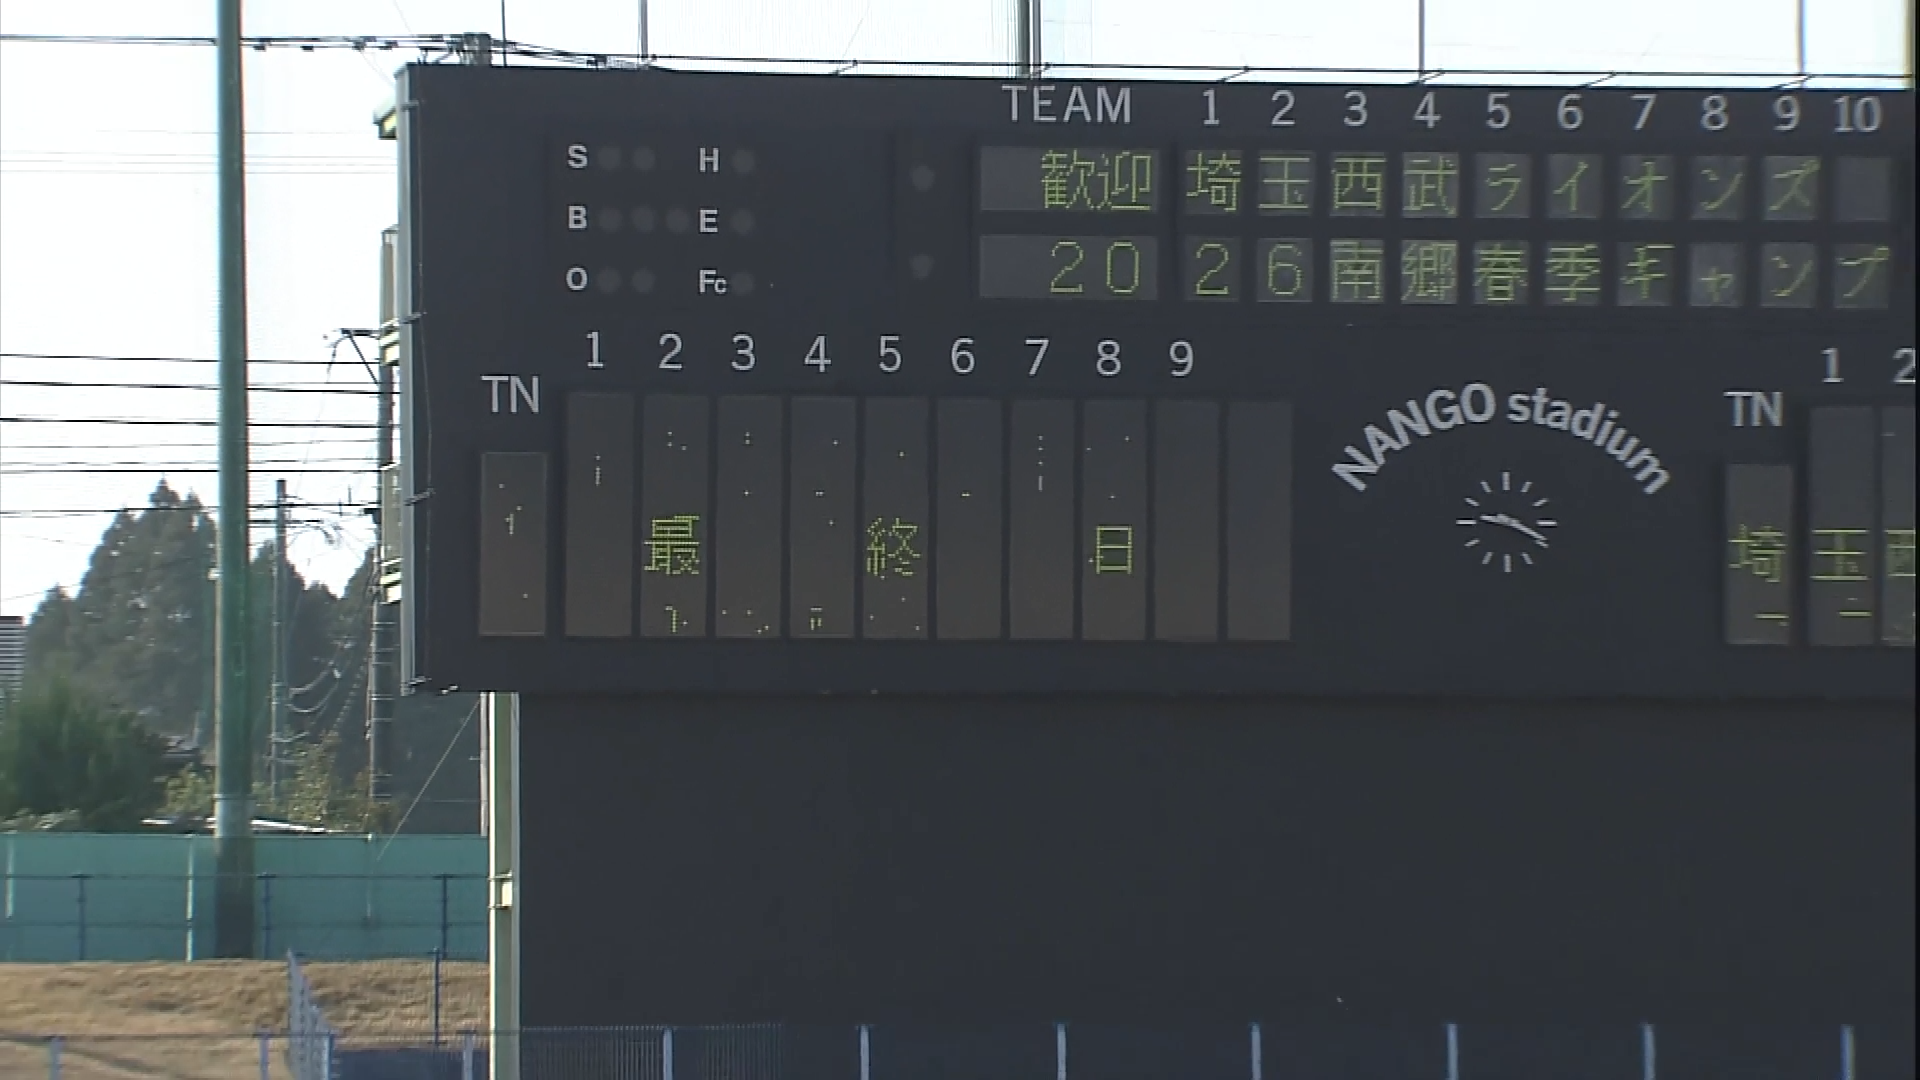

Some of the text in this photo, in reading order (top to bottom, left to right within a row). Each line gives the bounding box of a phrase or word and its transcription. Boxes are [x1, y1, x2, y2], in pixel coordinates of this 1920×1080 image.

[1001, 85, 1882, 133] TEAM 1 2 3 4 5 6 7 8 9 10
[567, 144, 588, 169] S
[699, 147, 719, 172] H
[568, 205, 588, 229] B
[699, 209, 718, 233] E
[566, 267, 588, 291] O
[699, 269, 727, 294] Fc
[586, 331, 1194, 377] 1 2 3 4 5 6 7 8 9
[1821, 347, 1916, 384] 1 2
[481, 375, 540, 413] TN
[1723, 391, 1783, 427] TN
[1331, 382, 1671, 495] NANGO stadium
